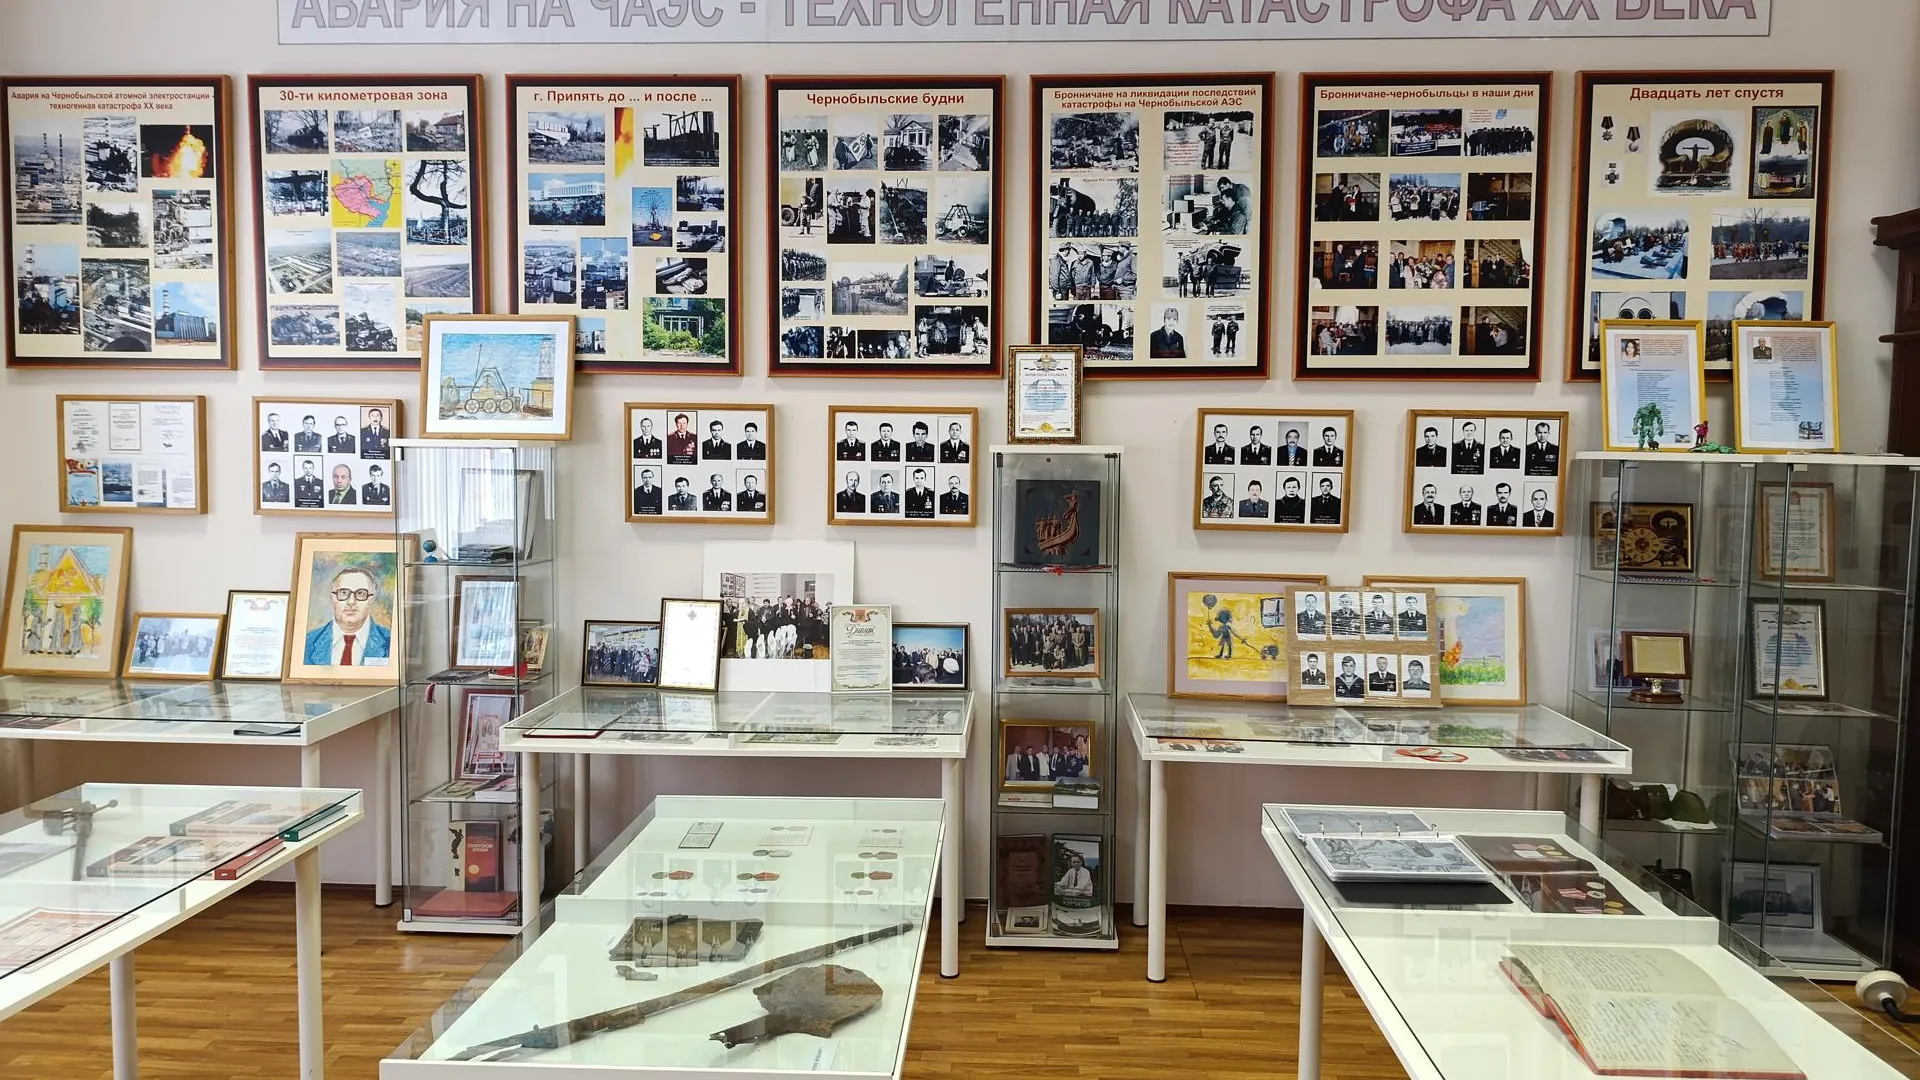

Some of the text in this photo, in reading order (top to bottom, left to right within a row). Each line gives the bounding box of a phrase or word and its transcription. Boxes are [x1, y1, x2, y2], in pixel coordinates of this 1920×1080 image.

[12, 92, 39, 100] Авария
[51, 90, 113, 100] Чернобыльской
[115, 92, 147, 100] атомной
[280, 90, 448, 103] 30-ти километровая зона
[534, 92, 543, 101] г.
[548, 91, 604, 103] Припять
[608, 93, 625, 103] до
[657, 93, 697, 102] после
[807, 92, 964, 106] Чернобыльские будни
[1055, 88, 1257, 100] Бронничане на ликвидации последствий
[1321, 89, 1469, 101] Бронничане-чернобыльцы
[1482, 90, 1510, 98] наши
[1513, 90, 1534, 99] дни
[1630, 88, 1784, 102] Двадцать лет спустя
[98, 103, 141, 111] катастрофа
[1062, 100, 1122, 109] катастрофы
[1139, 99, 1218, 108] Чернобыльской
[1221, 98, 1243, 106] АЭС
